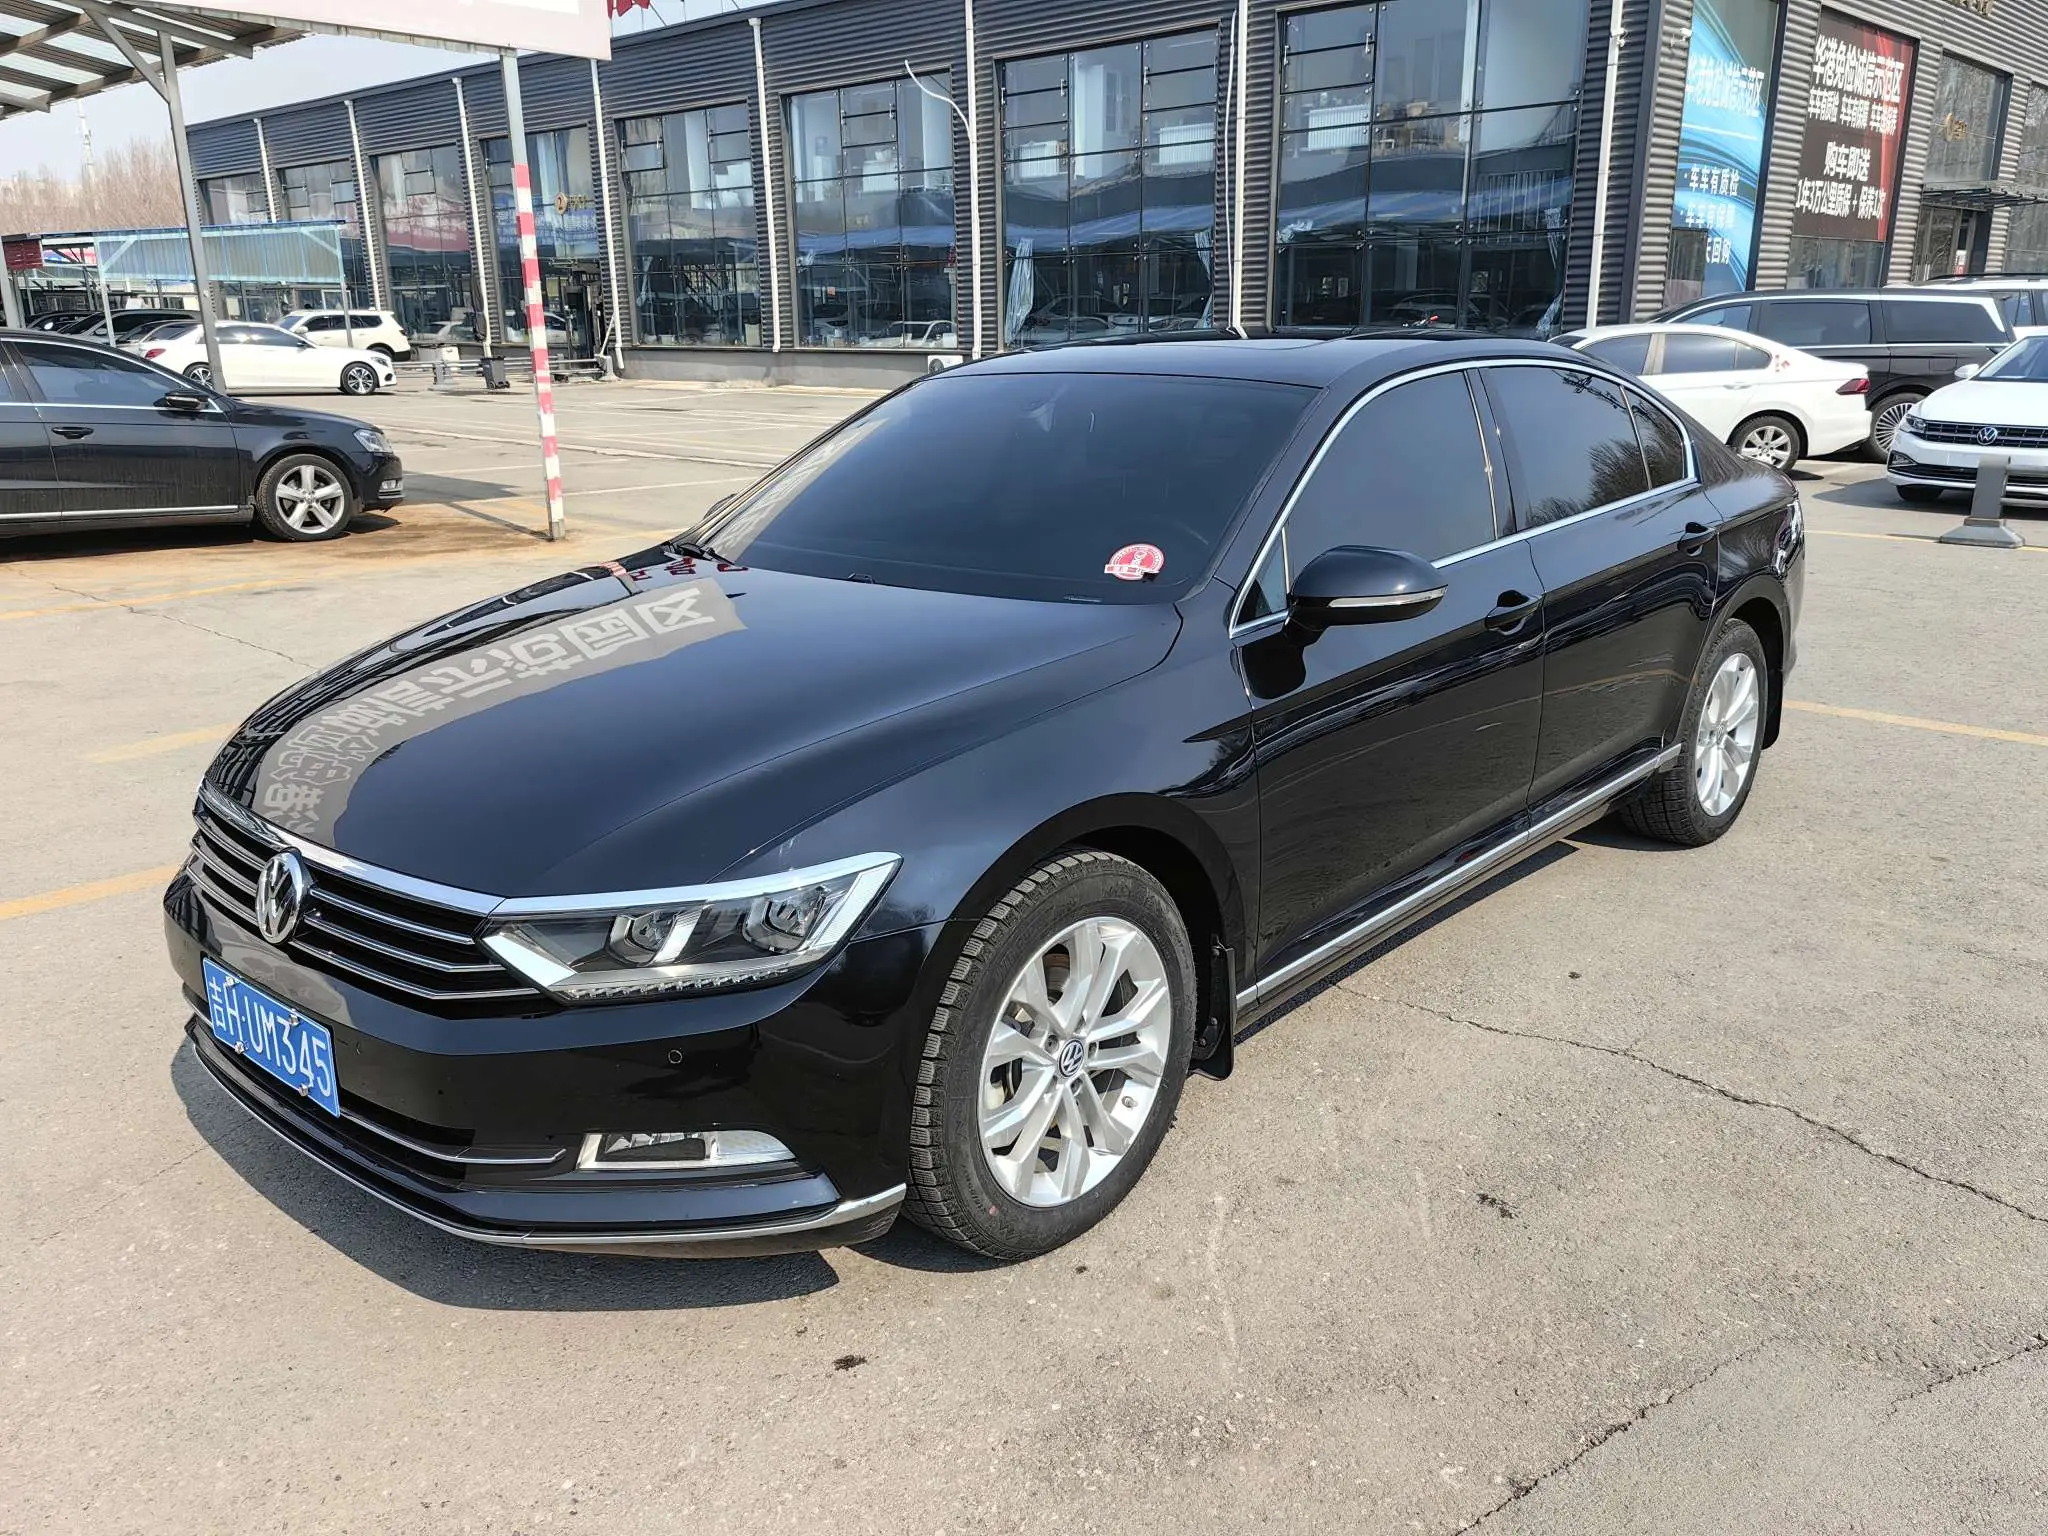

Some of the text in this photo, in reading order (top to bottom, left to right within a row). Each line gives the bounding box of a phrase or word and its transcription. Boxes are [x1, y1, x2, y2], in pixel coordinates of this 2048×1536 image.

[1813, 34, 1904, 103] 华港免检诚信示范区
[1689, 164, 1740, 196] 车车有质检
[1824, 141, 1871, 181] 购车即送
